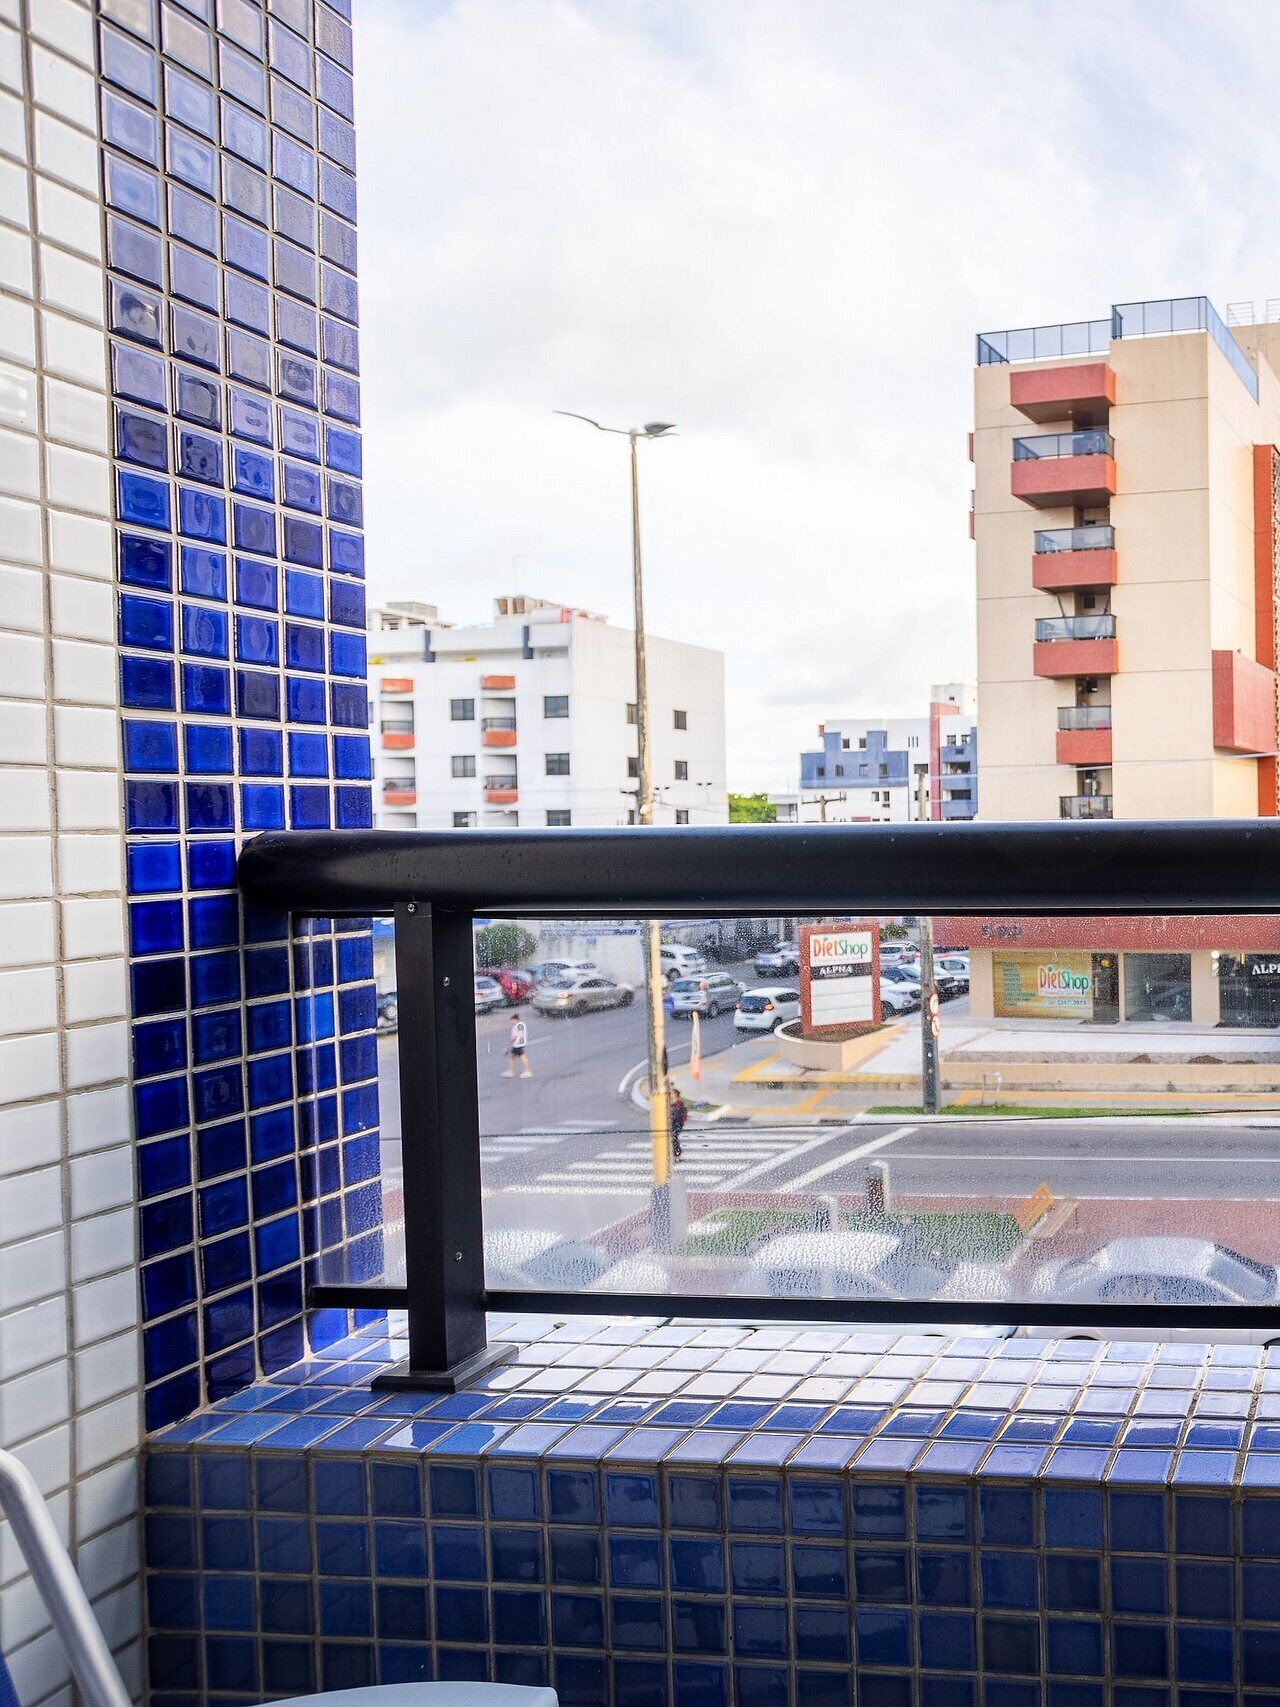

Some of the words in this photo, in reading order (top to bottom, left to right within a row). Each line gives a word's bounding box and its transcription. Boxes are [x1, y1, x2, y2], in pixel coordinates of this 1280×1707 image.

[813, 937, 868, 959] DietShop
[819, 965, 853, 976] ALPHA
[1039, 965, 1089, 995] DietShop
